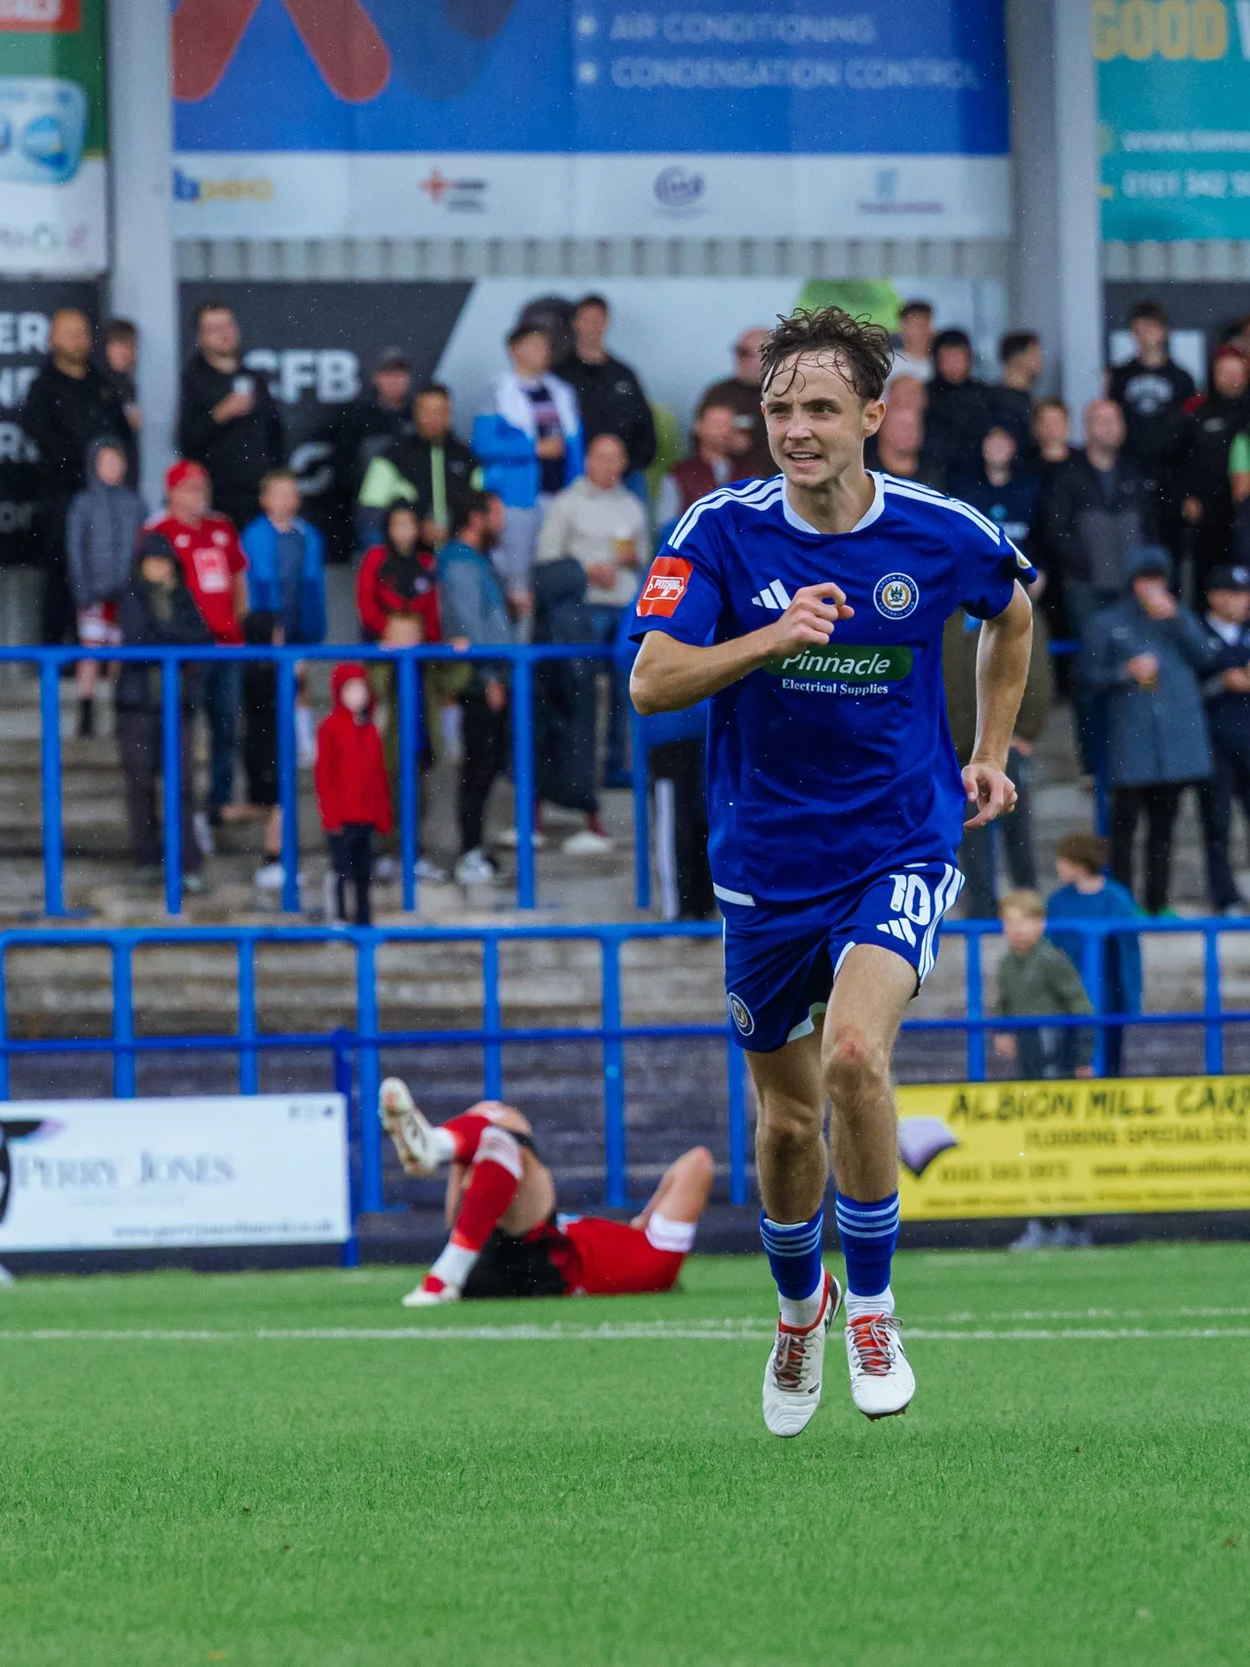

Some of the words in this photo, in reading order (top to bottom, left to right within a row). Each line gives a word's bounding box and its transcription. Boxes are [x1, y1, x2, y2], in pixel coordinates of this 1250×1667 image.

[610, 13, 656, 41] AIR
[663, 13, 876, 43] CONDITIONING
[612, 57, 839, 88] CONDENSATION
[844, 58, 980, 90] CONTROL
[781, 678, 837, 693] Electrical
[839, 683, 889, 696] Supplies
[889, 874, 931, 926] 10
[951, 1086, 1074, 1122] ALBION
[1086, 1086, 1161, 1118] MILL
[1128, 1123, 1248, 1144] SPECIALISTS
[18, 1153, 121, 1189] PERRY
[140, 1151, 236, 1186] JONES
